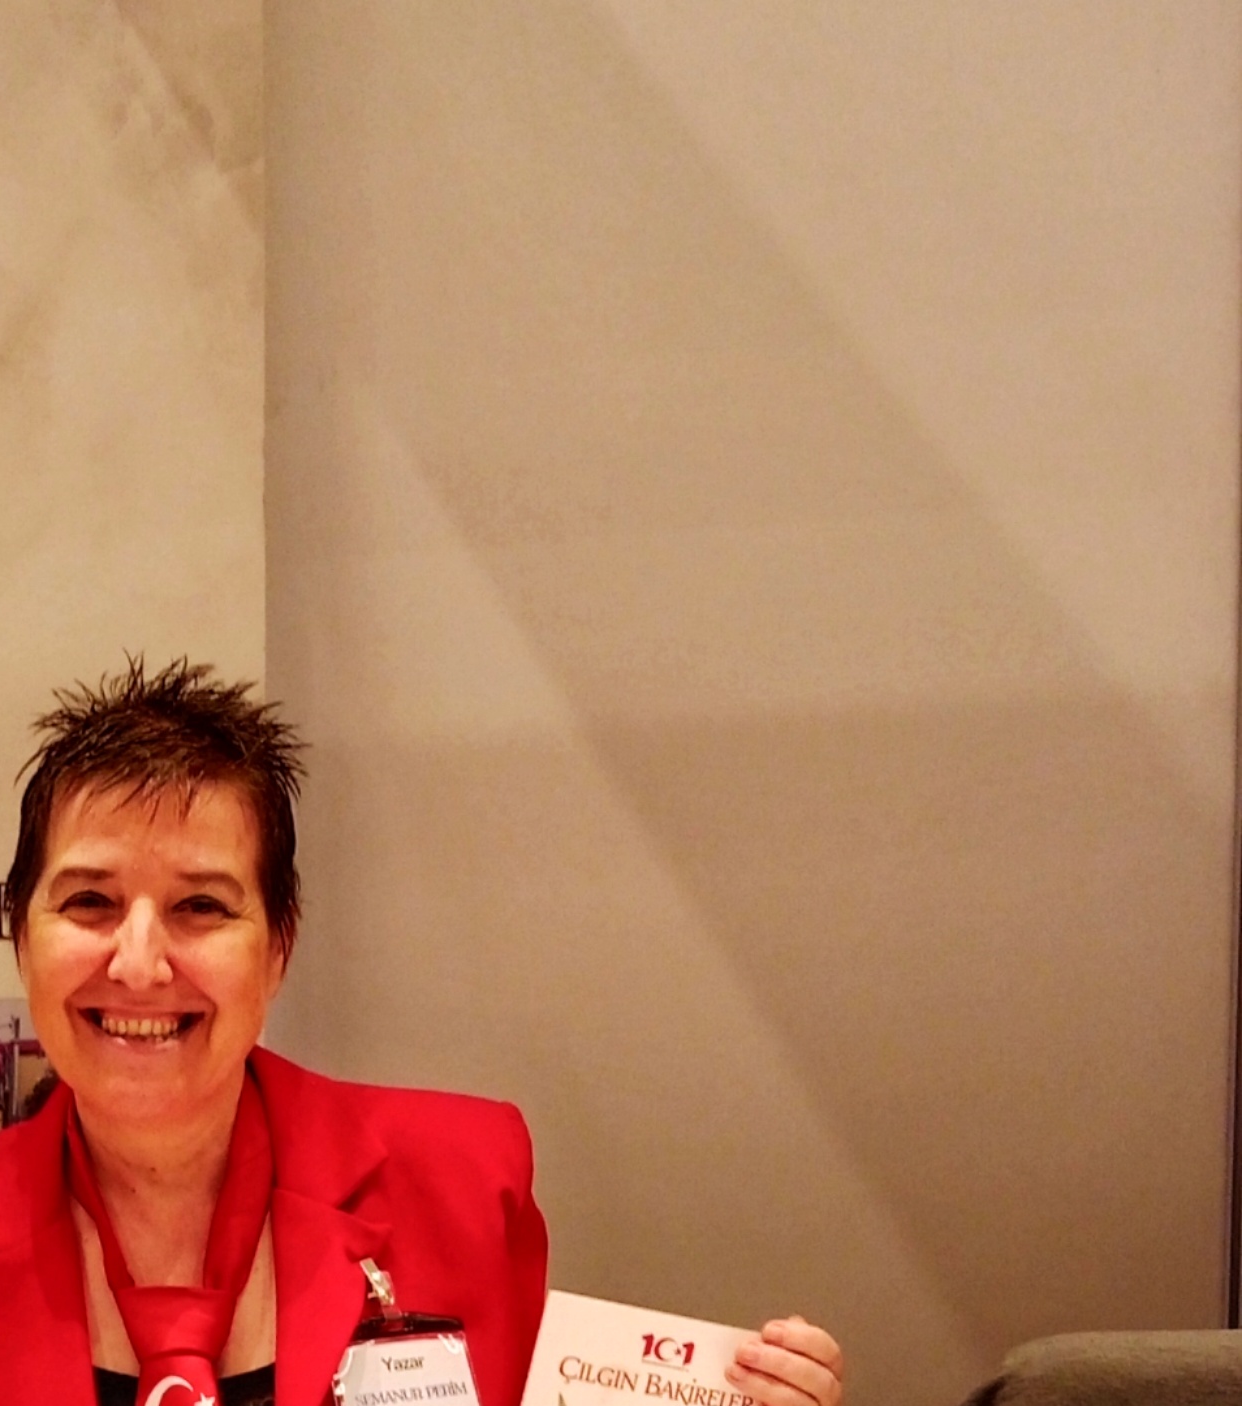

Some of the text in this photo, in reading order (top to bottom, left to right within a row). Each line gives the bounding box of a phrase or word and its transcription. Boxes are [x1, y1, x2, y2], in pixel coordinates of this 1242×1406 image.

[381, 1356, 425, 1372] Yazar
[558, 1356, 639, 1391] ÇILGIN
[427, 1379, 468, 1399] PERİM
